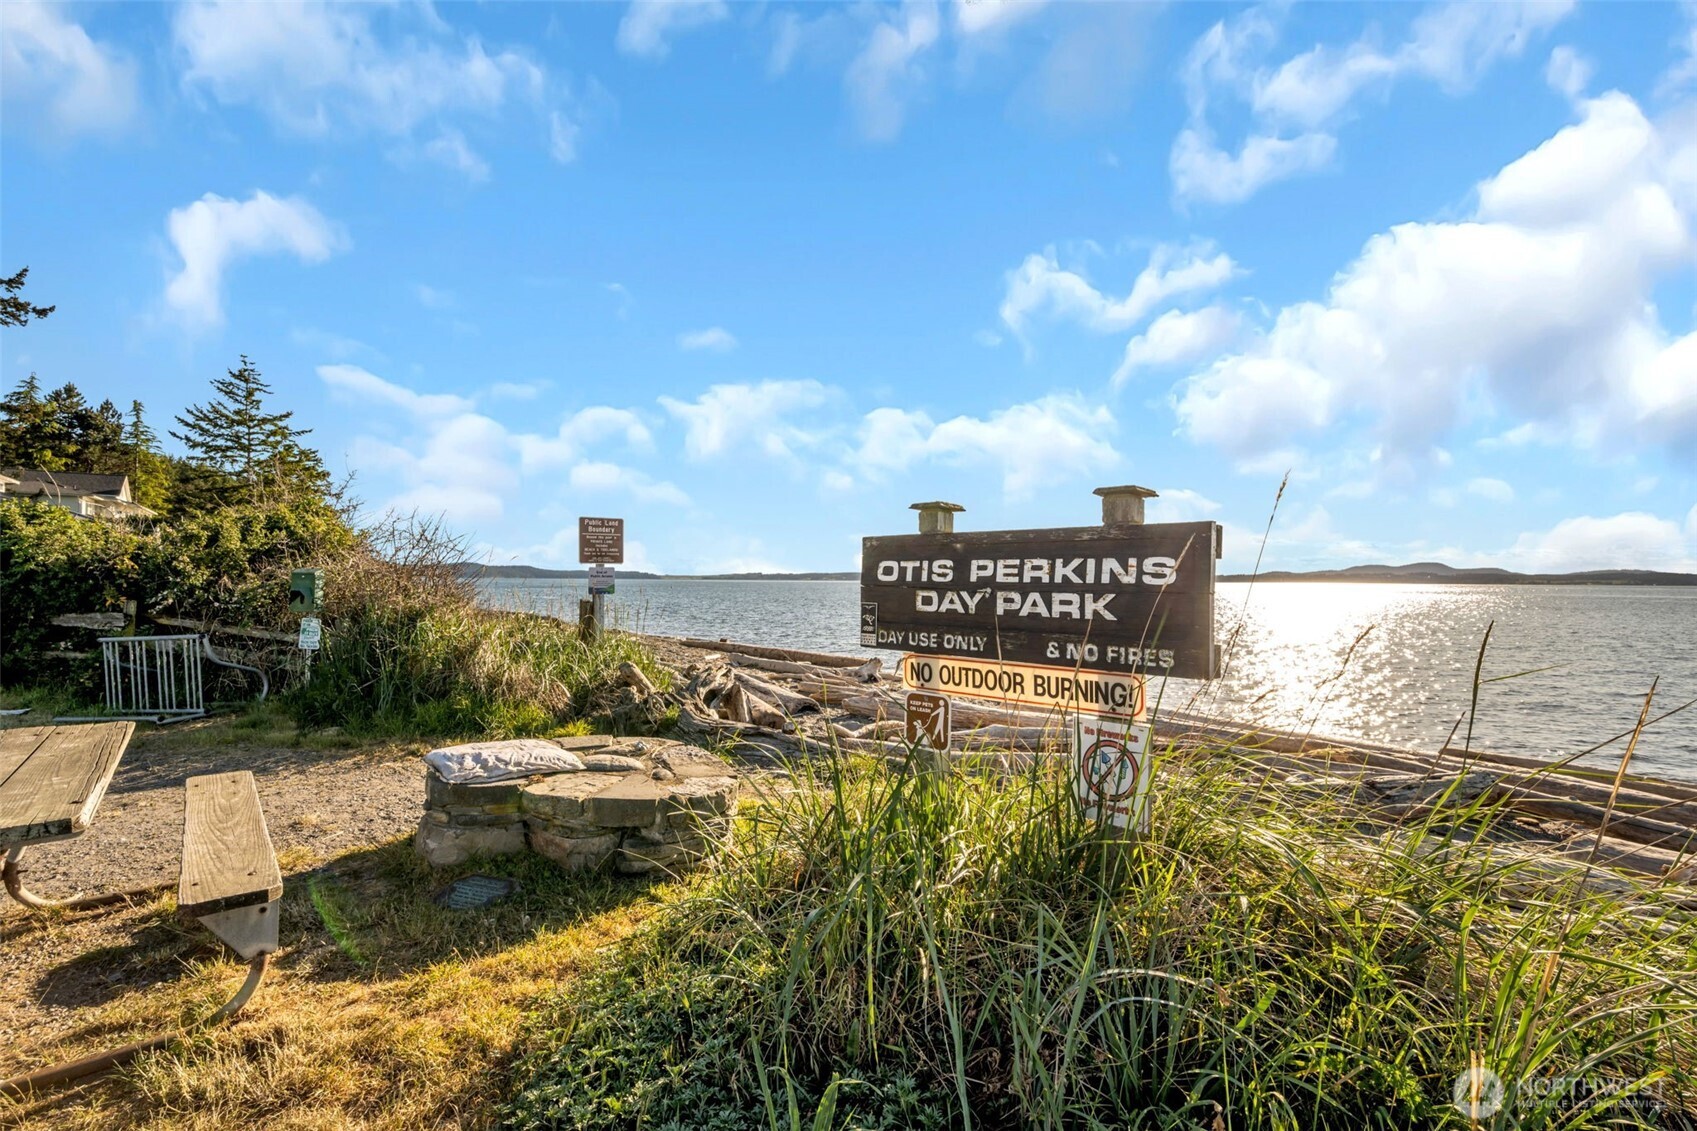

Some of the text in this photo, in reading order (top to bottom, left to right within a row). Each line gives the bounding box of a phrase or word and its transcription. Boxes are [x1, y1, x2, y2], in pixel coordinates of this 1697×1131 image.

[584, 518, 602, 526] Public
[877, 557, 1177, 585] OTIS PERKINS
[915, 589, 1118, 621] DAY PARK
[878, 629, 905, 645] DAY
[908, 632, 938, 648] USE
[943, 633, 988, 652] ONLY
[1046, 641, 1060, 658] &
[1066, 642, 1099, 662] NO
[1106, 645, 1175, 668] FIRES
[910, 661, 1134, 708] NO OUTDOOR BURNING!
[1084, 725, 1095, 735] No
